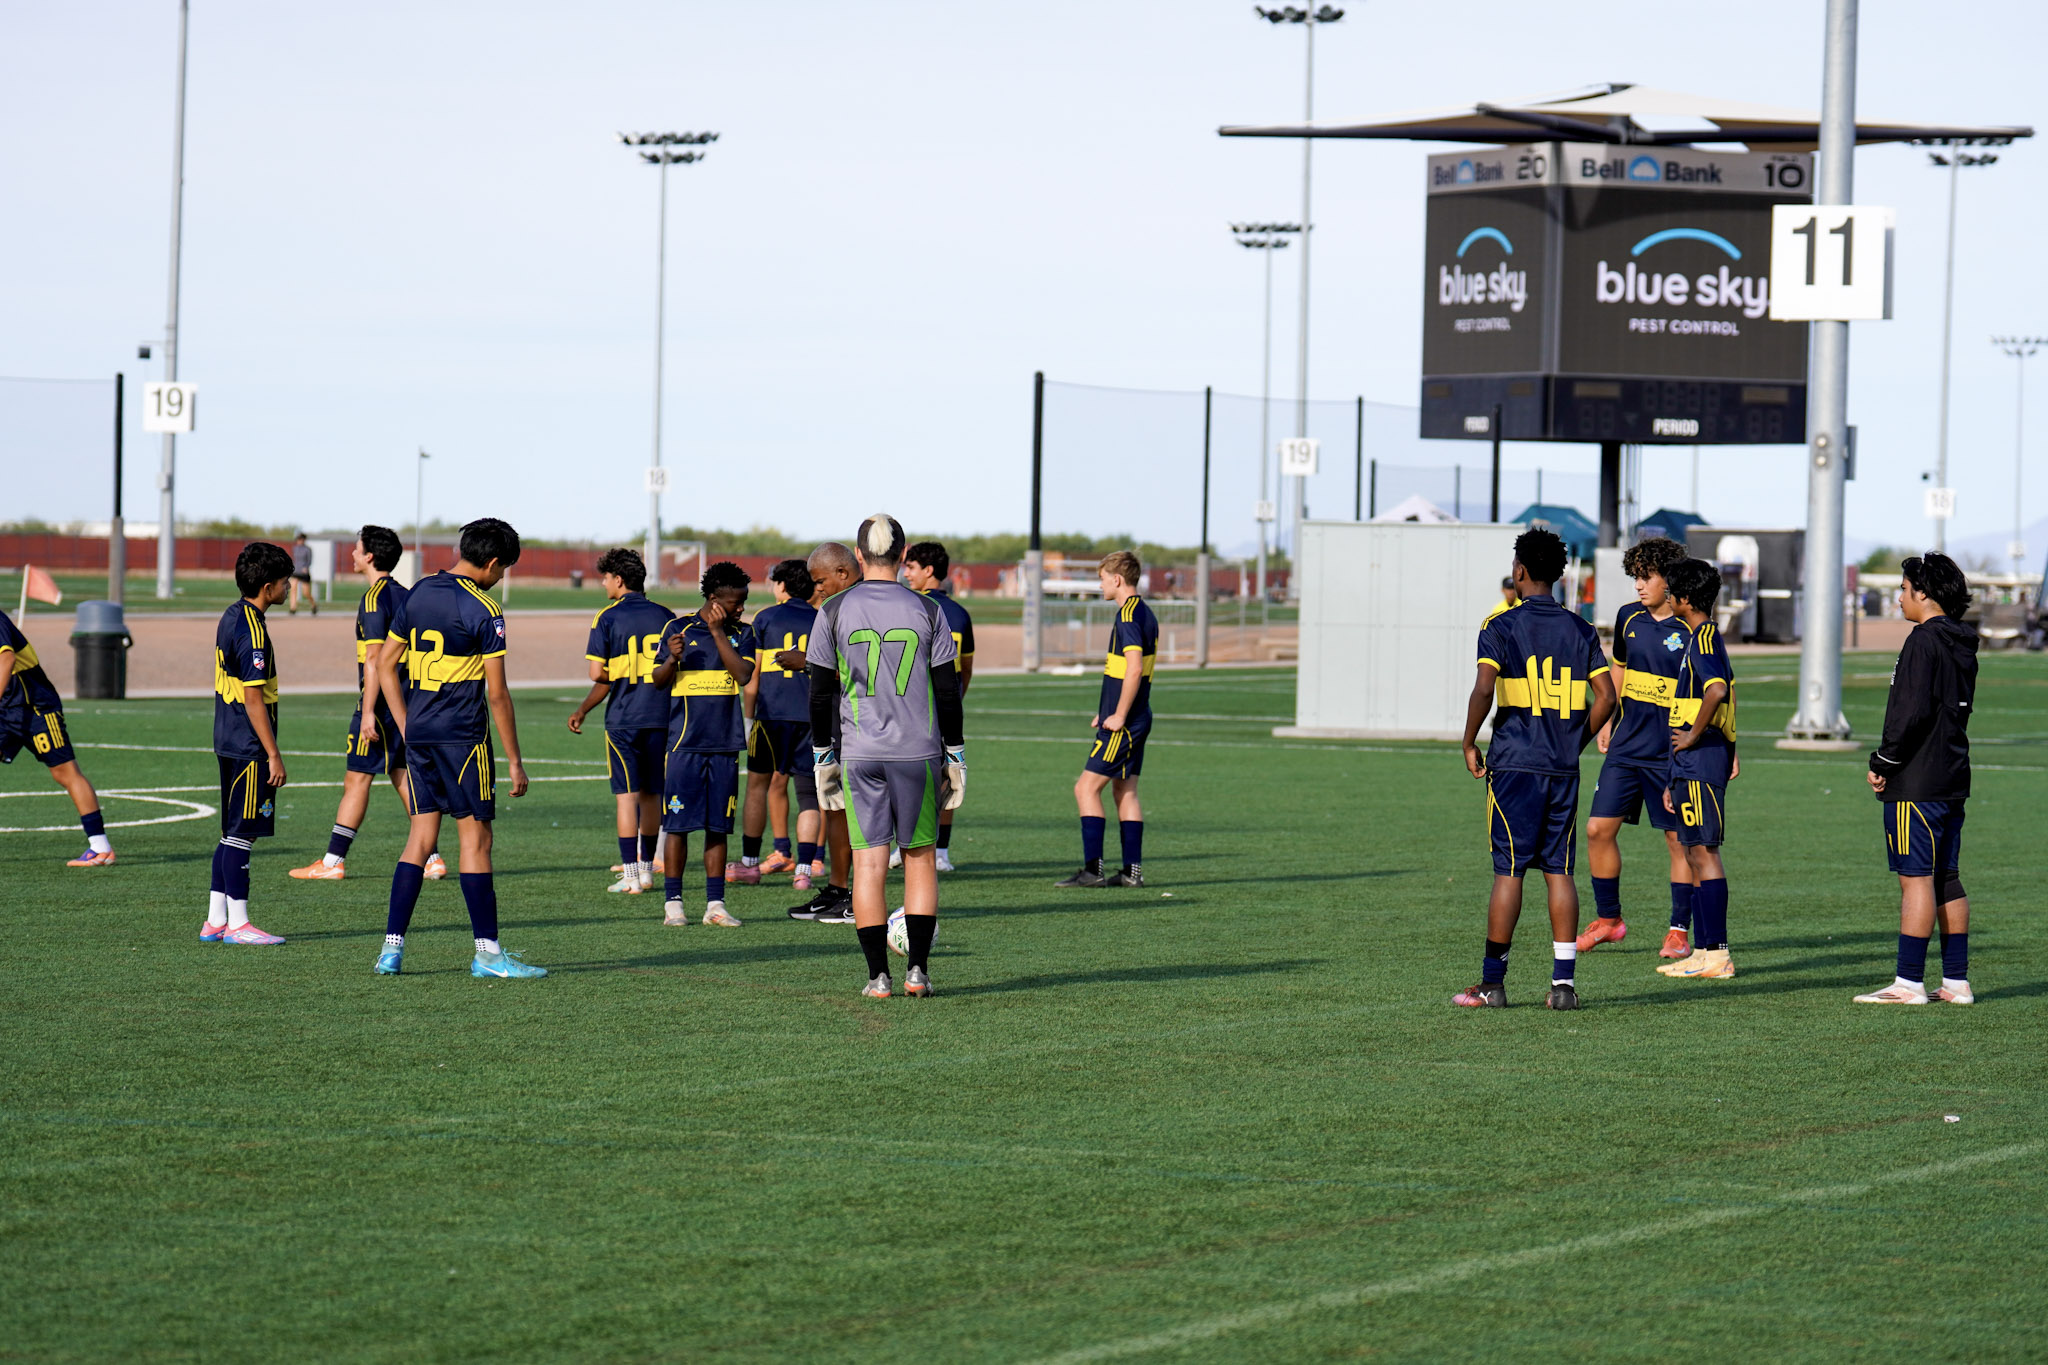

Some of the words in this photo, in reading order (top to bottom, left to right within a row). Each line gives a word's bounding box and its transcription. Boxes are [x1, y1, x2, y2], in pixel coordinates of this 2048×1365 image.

[1434, 164, 1457, 185] Bell
[1475, 161, 1504, 182] Bank
[1518, 155, 1546, 180] 20
[1581, 158, 1625, 179] Bell
[1664, 161, 1723, 183] Bank
[1764, 162, 1806, 188] 10
[1792, 216, 1854, 286] 11
[1439, 264, 1487, 306] blue
[1487, 261, 1527, 312] sky
[1596, 260, 1690, 306] blue
[1695, 265, 1768, 319] sky
[1629, 317, 1667, 334] PEST
[1669, 319, 1740, 336] CONTROL
[151, 387, 183, 417] 19
[1653, 418, 1699, 436] PERIOD
[1288, 441, 1311, 464] 19
[410, 627, 444, 692] 12
[848, 628, 920, 697] 77
[1526, 655, 1571, 720] 14
[33, 732, 51, 754] 18
[1090, 739, 1103, 758] 7
[1681, 802, 1696, 827] 6
